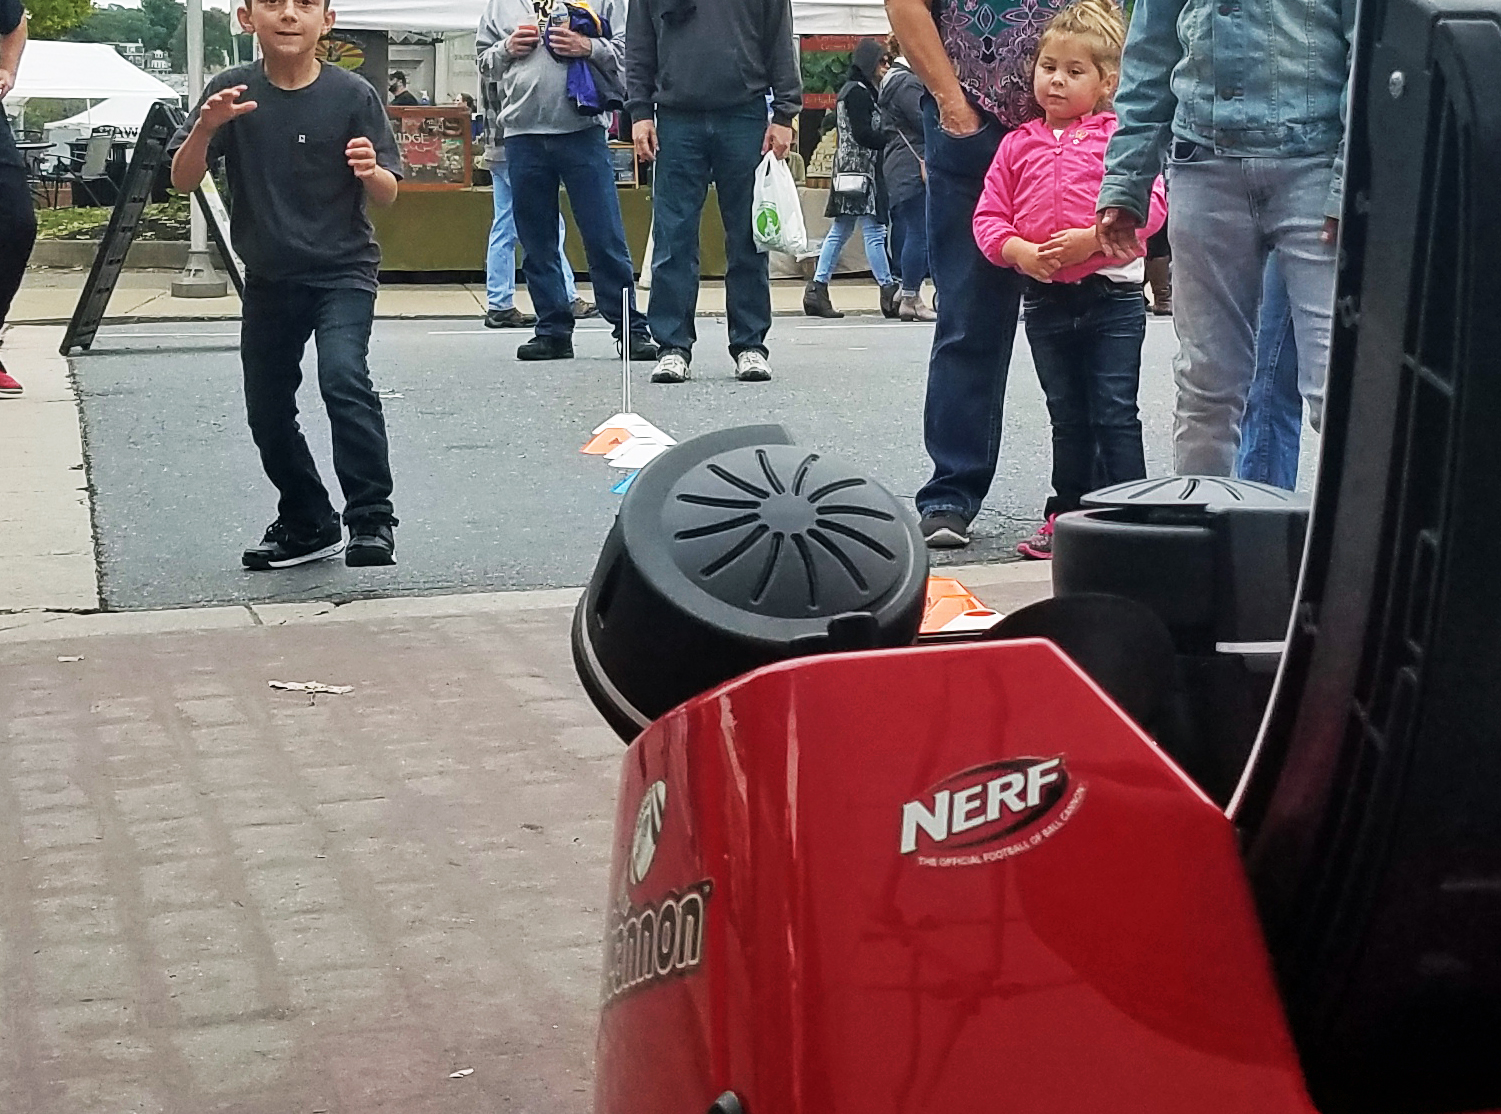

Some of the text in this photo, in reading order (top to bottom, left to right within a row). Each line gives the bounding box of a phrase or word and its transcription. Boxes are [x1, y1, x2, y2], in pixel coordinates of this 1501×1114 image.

[394, 132, 430, 144] UDGE
[901, 758, 1060, 854] NERF
[918, 785, 1086, 867] THE OFFICIAL FOOTBALL OF BALL CANNON
[605, 893, 704, 998] annon
